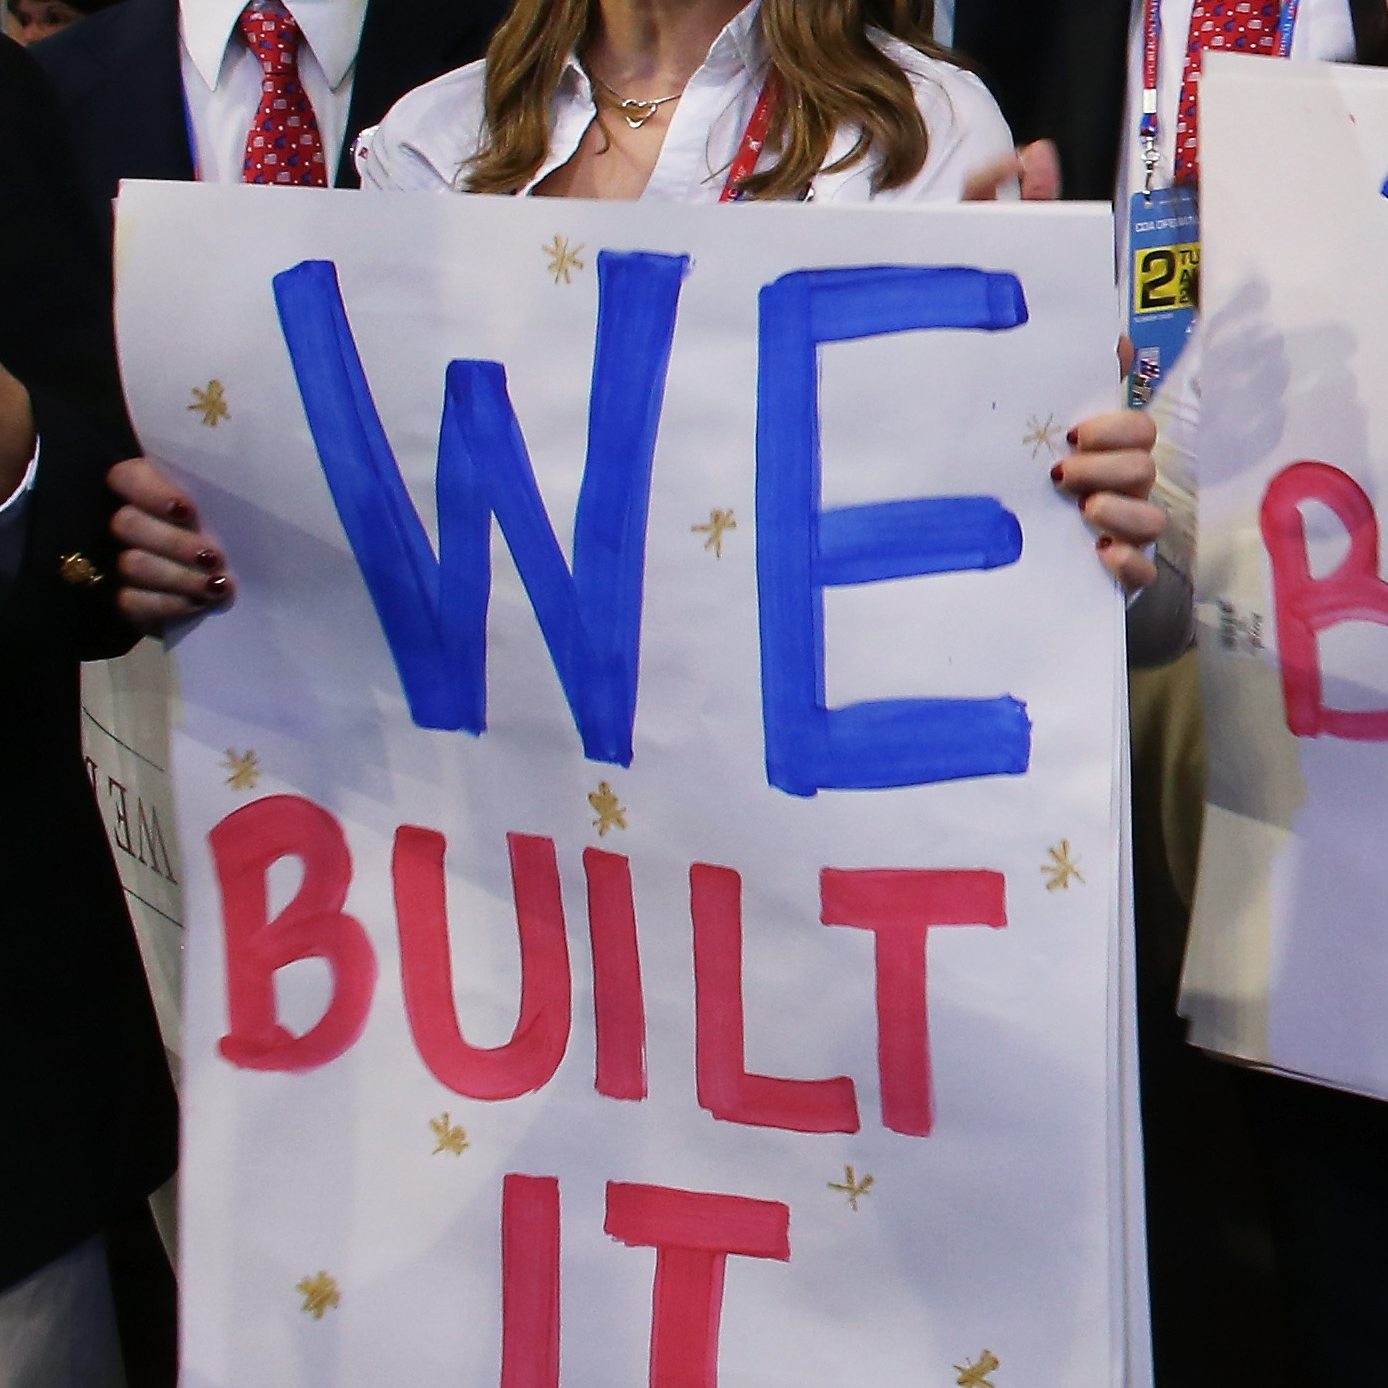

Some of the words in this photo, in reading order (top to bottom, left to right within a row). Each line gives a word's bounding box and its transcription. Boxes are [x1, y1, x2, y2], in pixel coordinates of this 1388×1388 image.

[1141, 249, 1176, 310] 2
[272, 250, 1032, 798] WE
[210, 794, 1008, 1139] BUILT
[501, 1174, 790, 1388] IT
